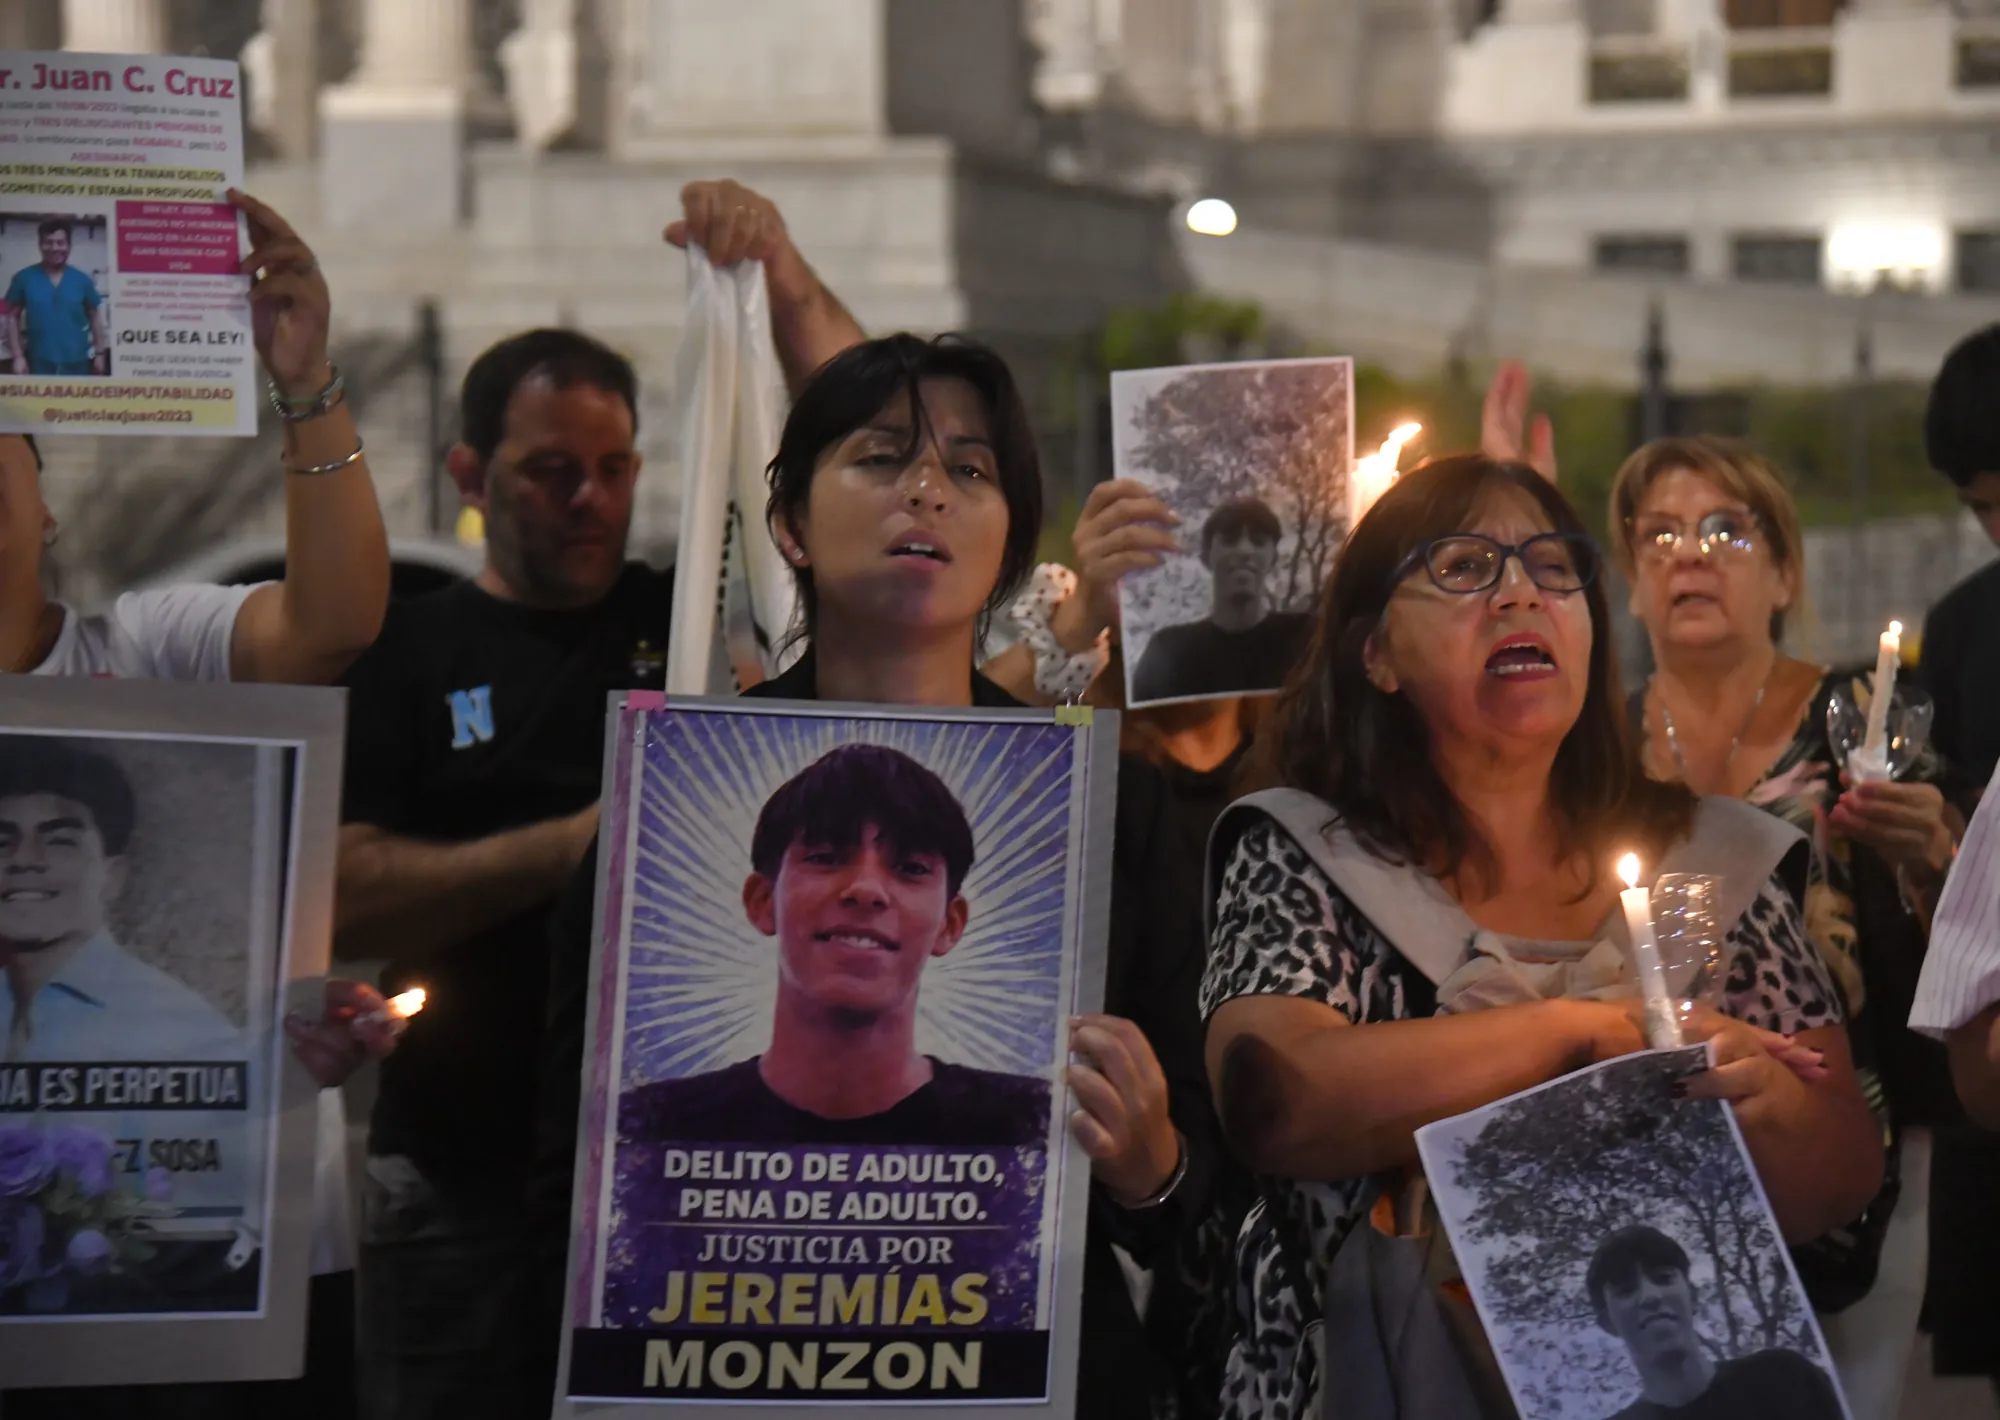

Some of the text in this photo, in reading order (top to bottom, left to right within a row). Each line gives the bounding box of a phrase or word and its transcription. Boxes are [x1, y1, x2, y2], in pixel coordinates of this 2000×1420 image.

[31, 64, 112, 91] Juan
[122, 66, 155, 93] C.
[164, 69, 234, 98] Cruz
[0, 181, 75, 195] COMETIDOS
[15, 164, 46, 175] TRES
[47, 166, 110, 177] MENORES
[114, 168, 128, 178] YA
[178, 170, 225, 182] DELITOS
[117, 329, 244, 346] ¡QUE SEA LEY!
[445, 684, 496, 752] N
[39, 1067, 79, 1105] ES
[84, 1066, 239, 1105] PERPETUA
[149, 1138, 220, 1173] SOSA
[664, 1149, 1005, 1187] DELITO DE ADULTO,
[679, 1189, 988, 1221] PENA DE ADULTO.
[697, 1234, 953, 1264] JUSTICIA POR
[647, 1265, 989, 1326] JEREMÍAS
[643, 1339, 983, 1390] MONZON
